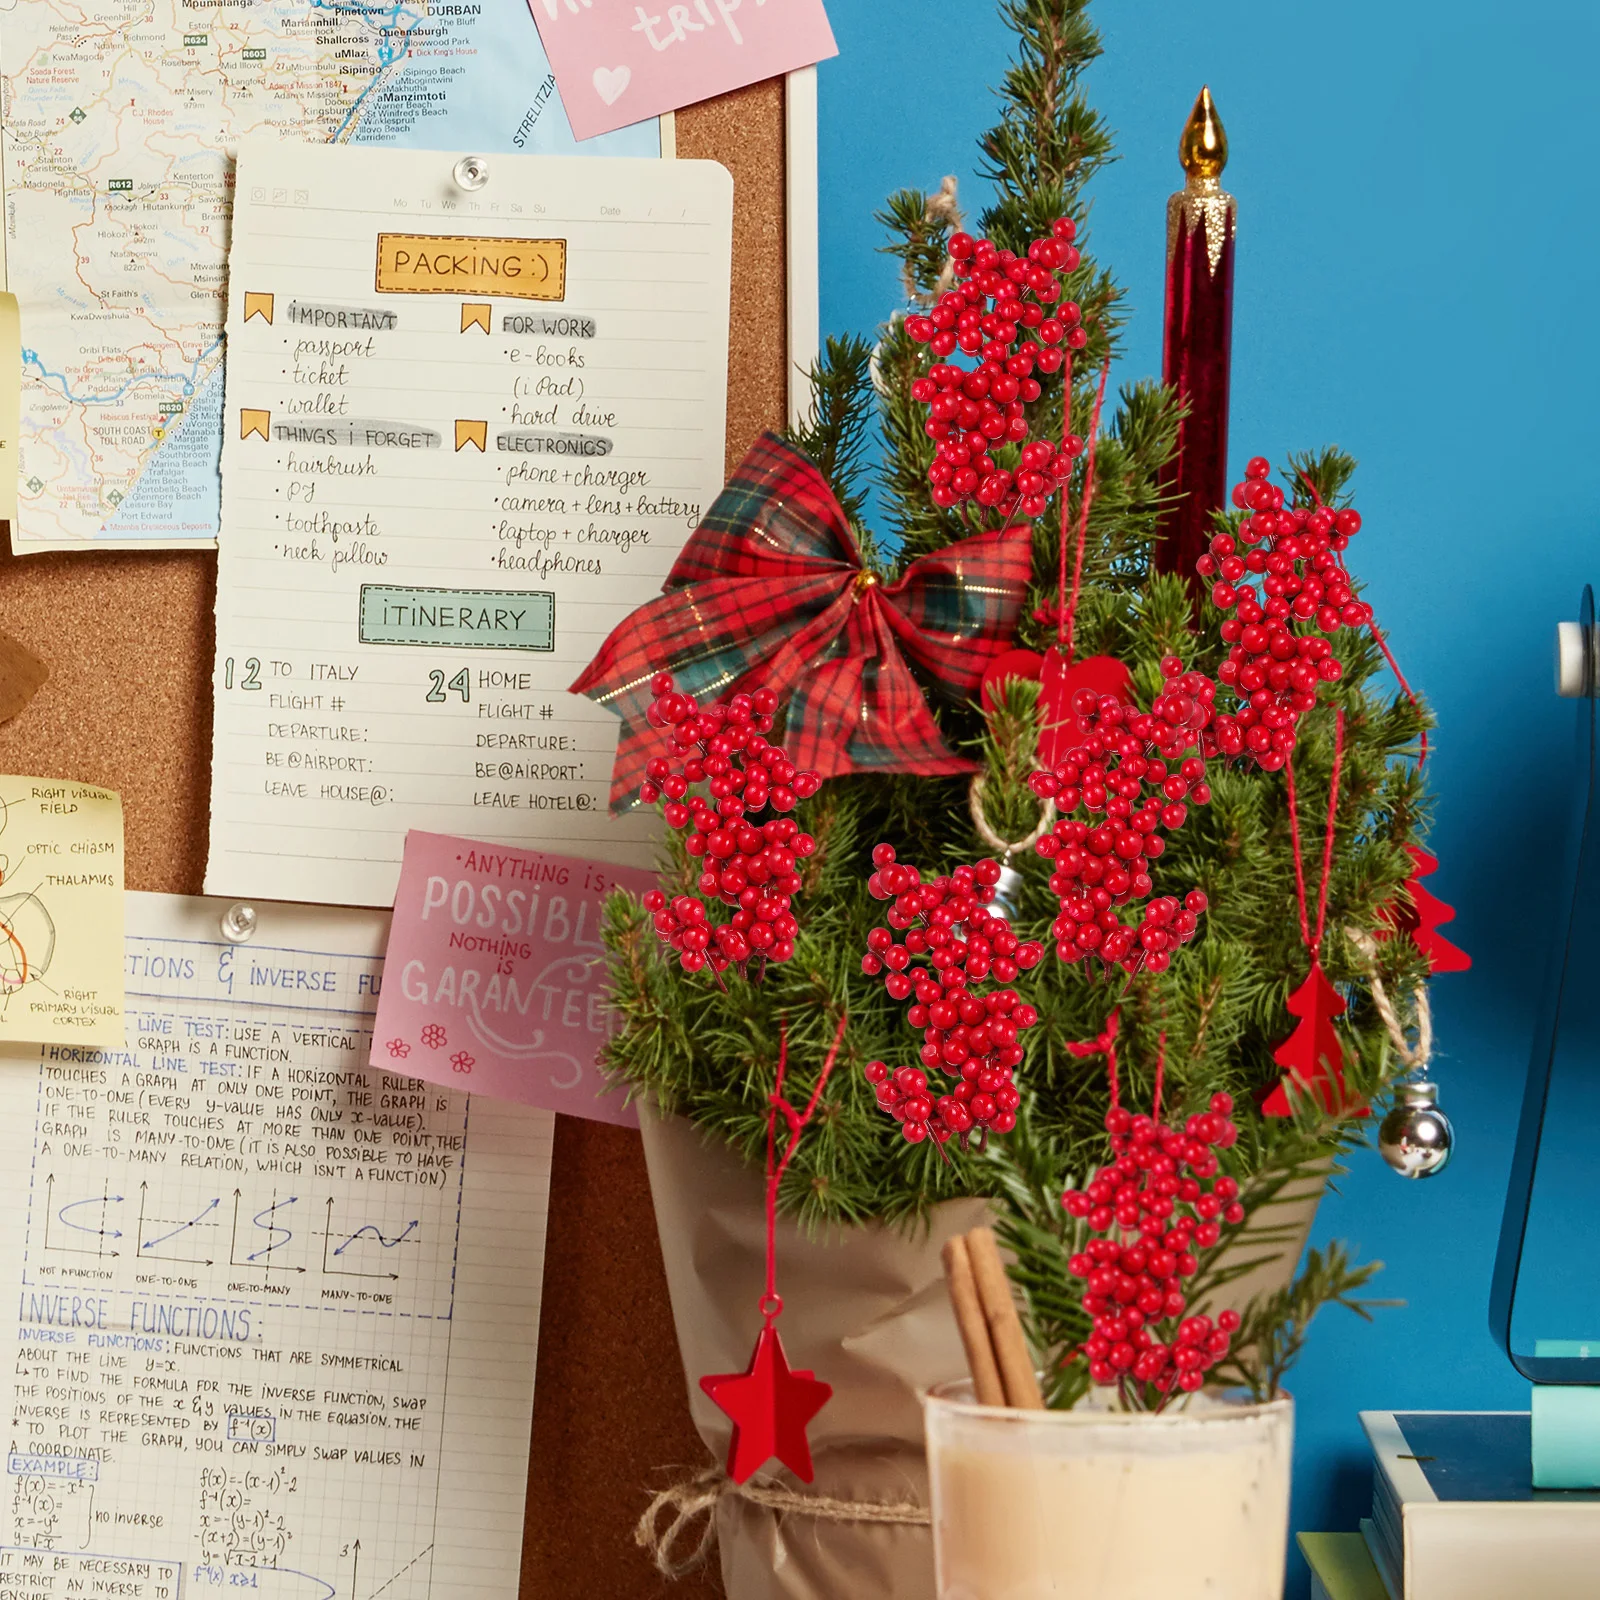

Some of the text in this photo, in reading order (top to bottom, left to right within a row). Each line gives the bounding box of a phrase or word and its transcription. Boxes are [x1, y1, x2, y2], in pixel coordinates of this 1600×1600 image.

[335, 7, 384, 16] Pinetown
[427, 6, 481, 16] DURBAN
[281, 18, 338, 27] Mariannhill
[457, 18, 475, 26] Bluff
[317, 36, 369, 44] Shallcross
[379, 27, 448, 37] Queensburgh
[398, 38, 446, 46] Yellowwood
[335, 50, 369, 58] uMlazi
[416, 48, 432, 56] Dick
[434, 48, 453, 57] King's
[340, 66, 382, 75] iSipingo
[404, 67, 465, 75] iSipingo Beach
[377, 92, 446, 101] aManzimtoti
[512, 73, 557, 148] STRELITZIA
[356, 133, 396, 141] Karridene
[110, 181, 131, 189] R612
[394, 199, 620, 216] Mo Tu We Th Fr Sa Su Date
[503, 316, 592, 337] FOR WORK
[294, 337, 376, 366] passport
[292, 360, 349, 385] ticket
[288, 393, 349, 415] wallet
[512, 403, 619, 428] hard drive
[125, 427, 150, 435] COAST
[366, 430, 434, 448] FORGET
[100, 437, 119, 445] TOLL
[174, 436, 208, 444] Margate
[287, 451, 377, 475] hairbrush
[286, 511, 381, 542] toothpaste
[577, 521, 651, 553] charger
[284, 539, 387, 573] neck pillow
[498, 548, 601, 580] headphones
[270, 661, 358, 681] TO ITALY
[426, 668, 470, 702] 24
[479, 670, 530, 689] HOME
[265, 780, 308, 798] LEAVE
[473, 792, 520, 808] LEAVE
[46, 875, 114, 886] THALAMUS
[401, 956, 617, 1034] GARANTEE
[234, 1028, 261, 1041] USE
[138, 1037, 179, 1051] GRAPH
[46, 1068, 425, 1110] TOUCHES GRAPH ONLY GRAPH
[383, 1076, 425, 1091] RULER
[276, 1106, 342, 1121] HAS ONLY
[109, 1110, 381, 1143] RULER TOUCHES MORE THAN ONE
[286, 1145, 315, 1156] ALSO
[396, 1153, 412, 1164] TO
[418, 1153, 453, 1167] HAVE
[20, 1292, 108, 1330] INVERSE
[18, 1328, 76, 1343] INVERSE
[18, 1349, 58, 1362] ABOUT
[253, 1348, 283, 1363] THAT
[290, 1352, 312, 1364] ARE
[134, 1377, 188, 1391] FORMULA
[100, 1411, 190, 1429] REPRESENTED
[59, 1425, 91, 1439] PLOT
[12, 1458, 94, 1476] EXAMPLE:
[24, 1556, 150, 1579] MAY NECESSARY
